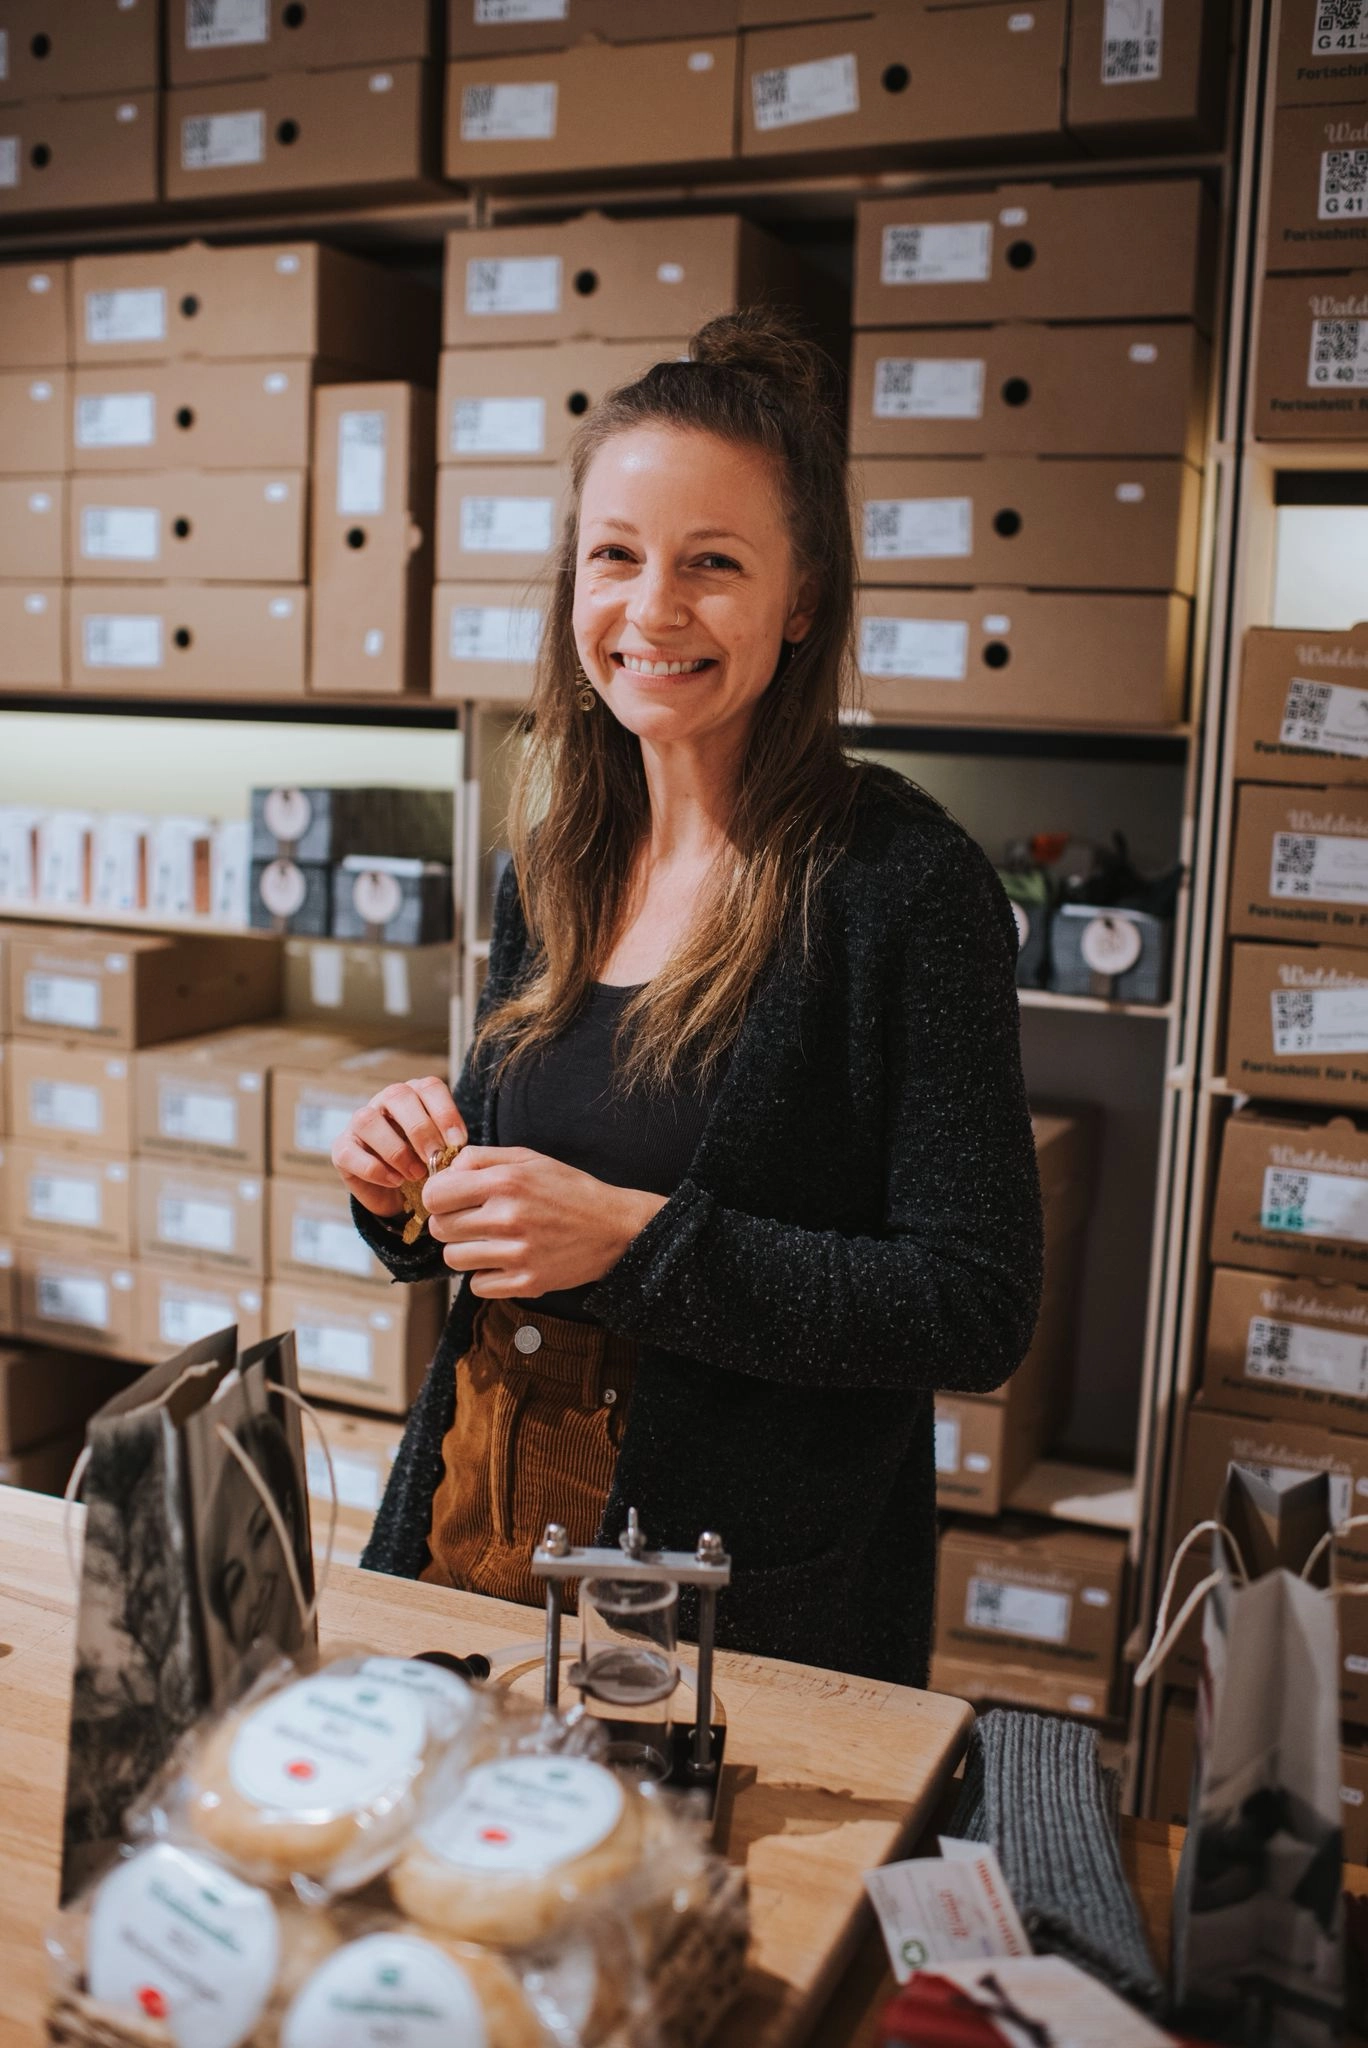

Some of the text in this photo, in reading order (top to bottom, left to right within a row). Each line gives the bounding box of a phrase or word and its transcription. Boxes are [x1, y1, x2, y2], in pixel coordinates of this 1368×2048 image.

[1318, 35, 1331, 49] G
[1336, 34, 1357, 48] 41
[1325, 197, 1364, 213] G 41
